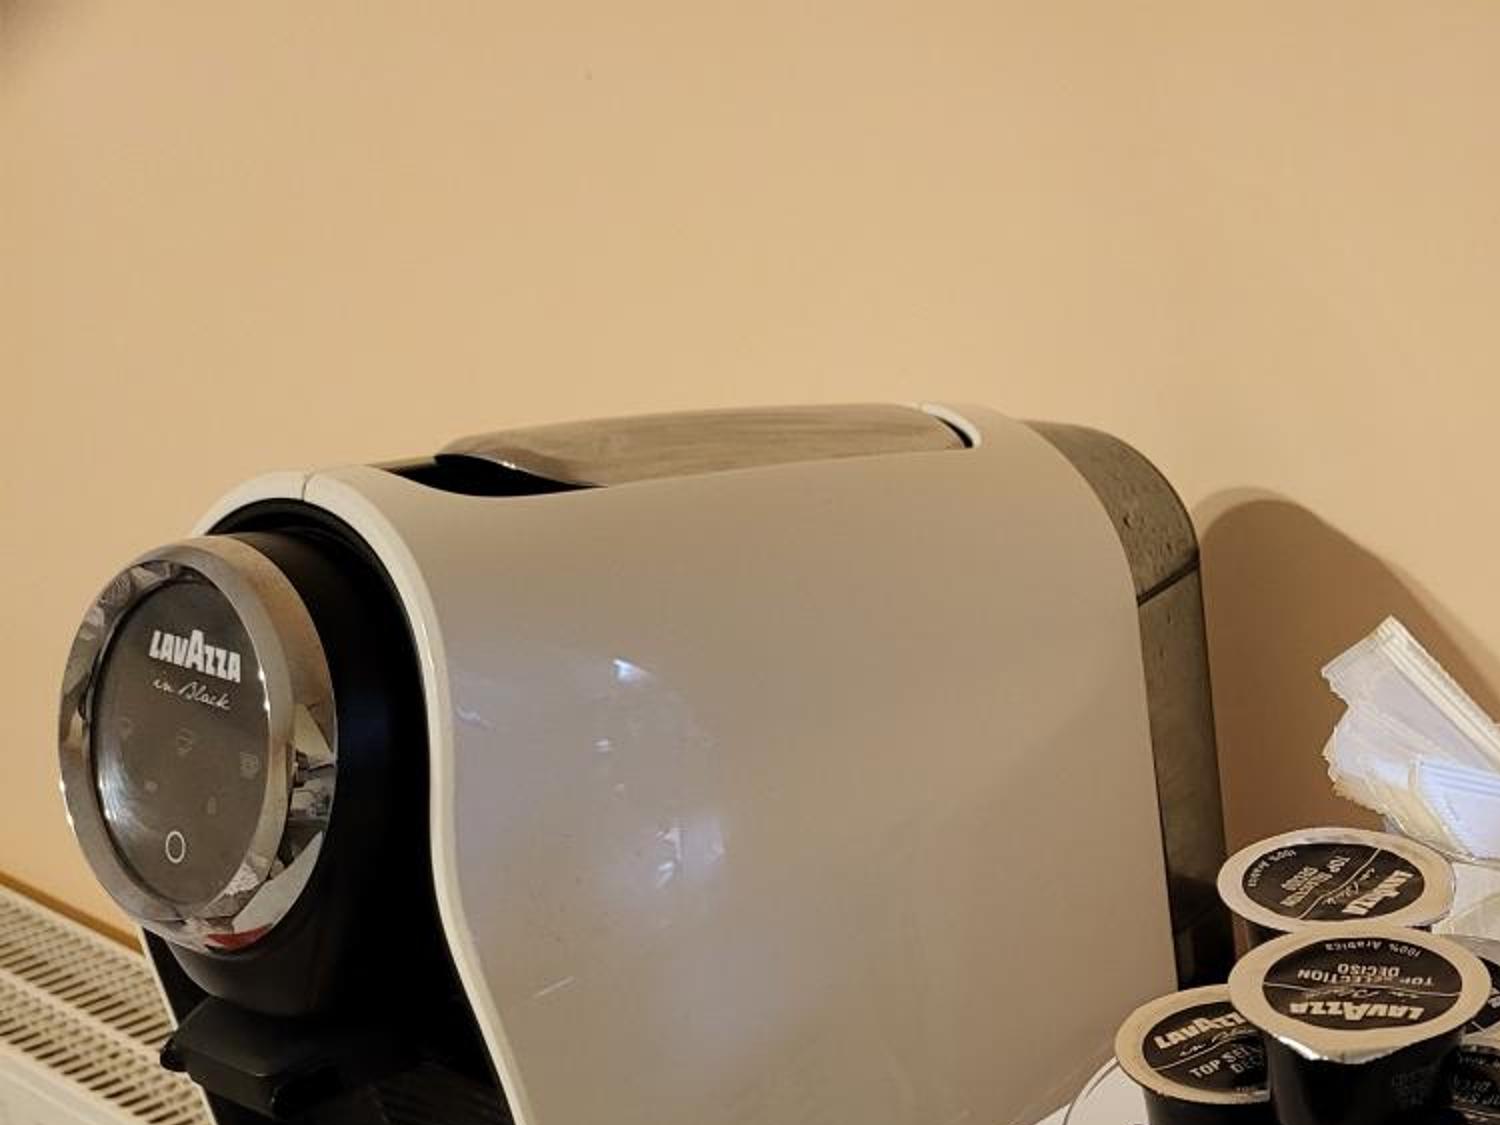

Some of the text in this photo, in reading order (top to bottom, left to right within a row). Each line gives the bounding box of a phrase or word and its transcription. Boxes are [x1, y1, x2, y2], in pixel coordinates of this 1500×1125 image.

[149, 629, 241, 683] LAVAZZA
[1337, 963, 1401, 977] DECISO
[1399, 975, 1435, 986] TOP
[1289, 1000, 1425, 1021] LAVAZZA
[1189, 1059, 1223, 1080] TOP
